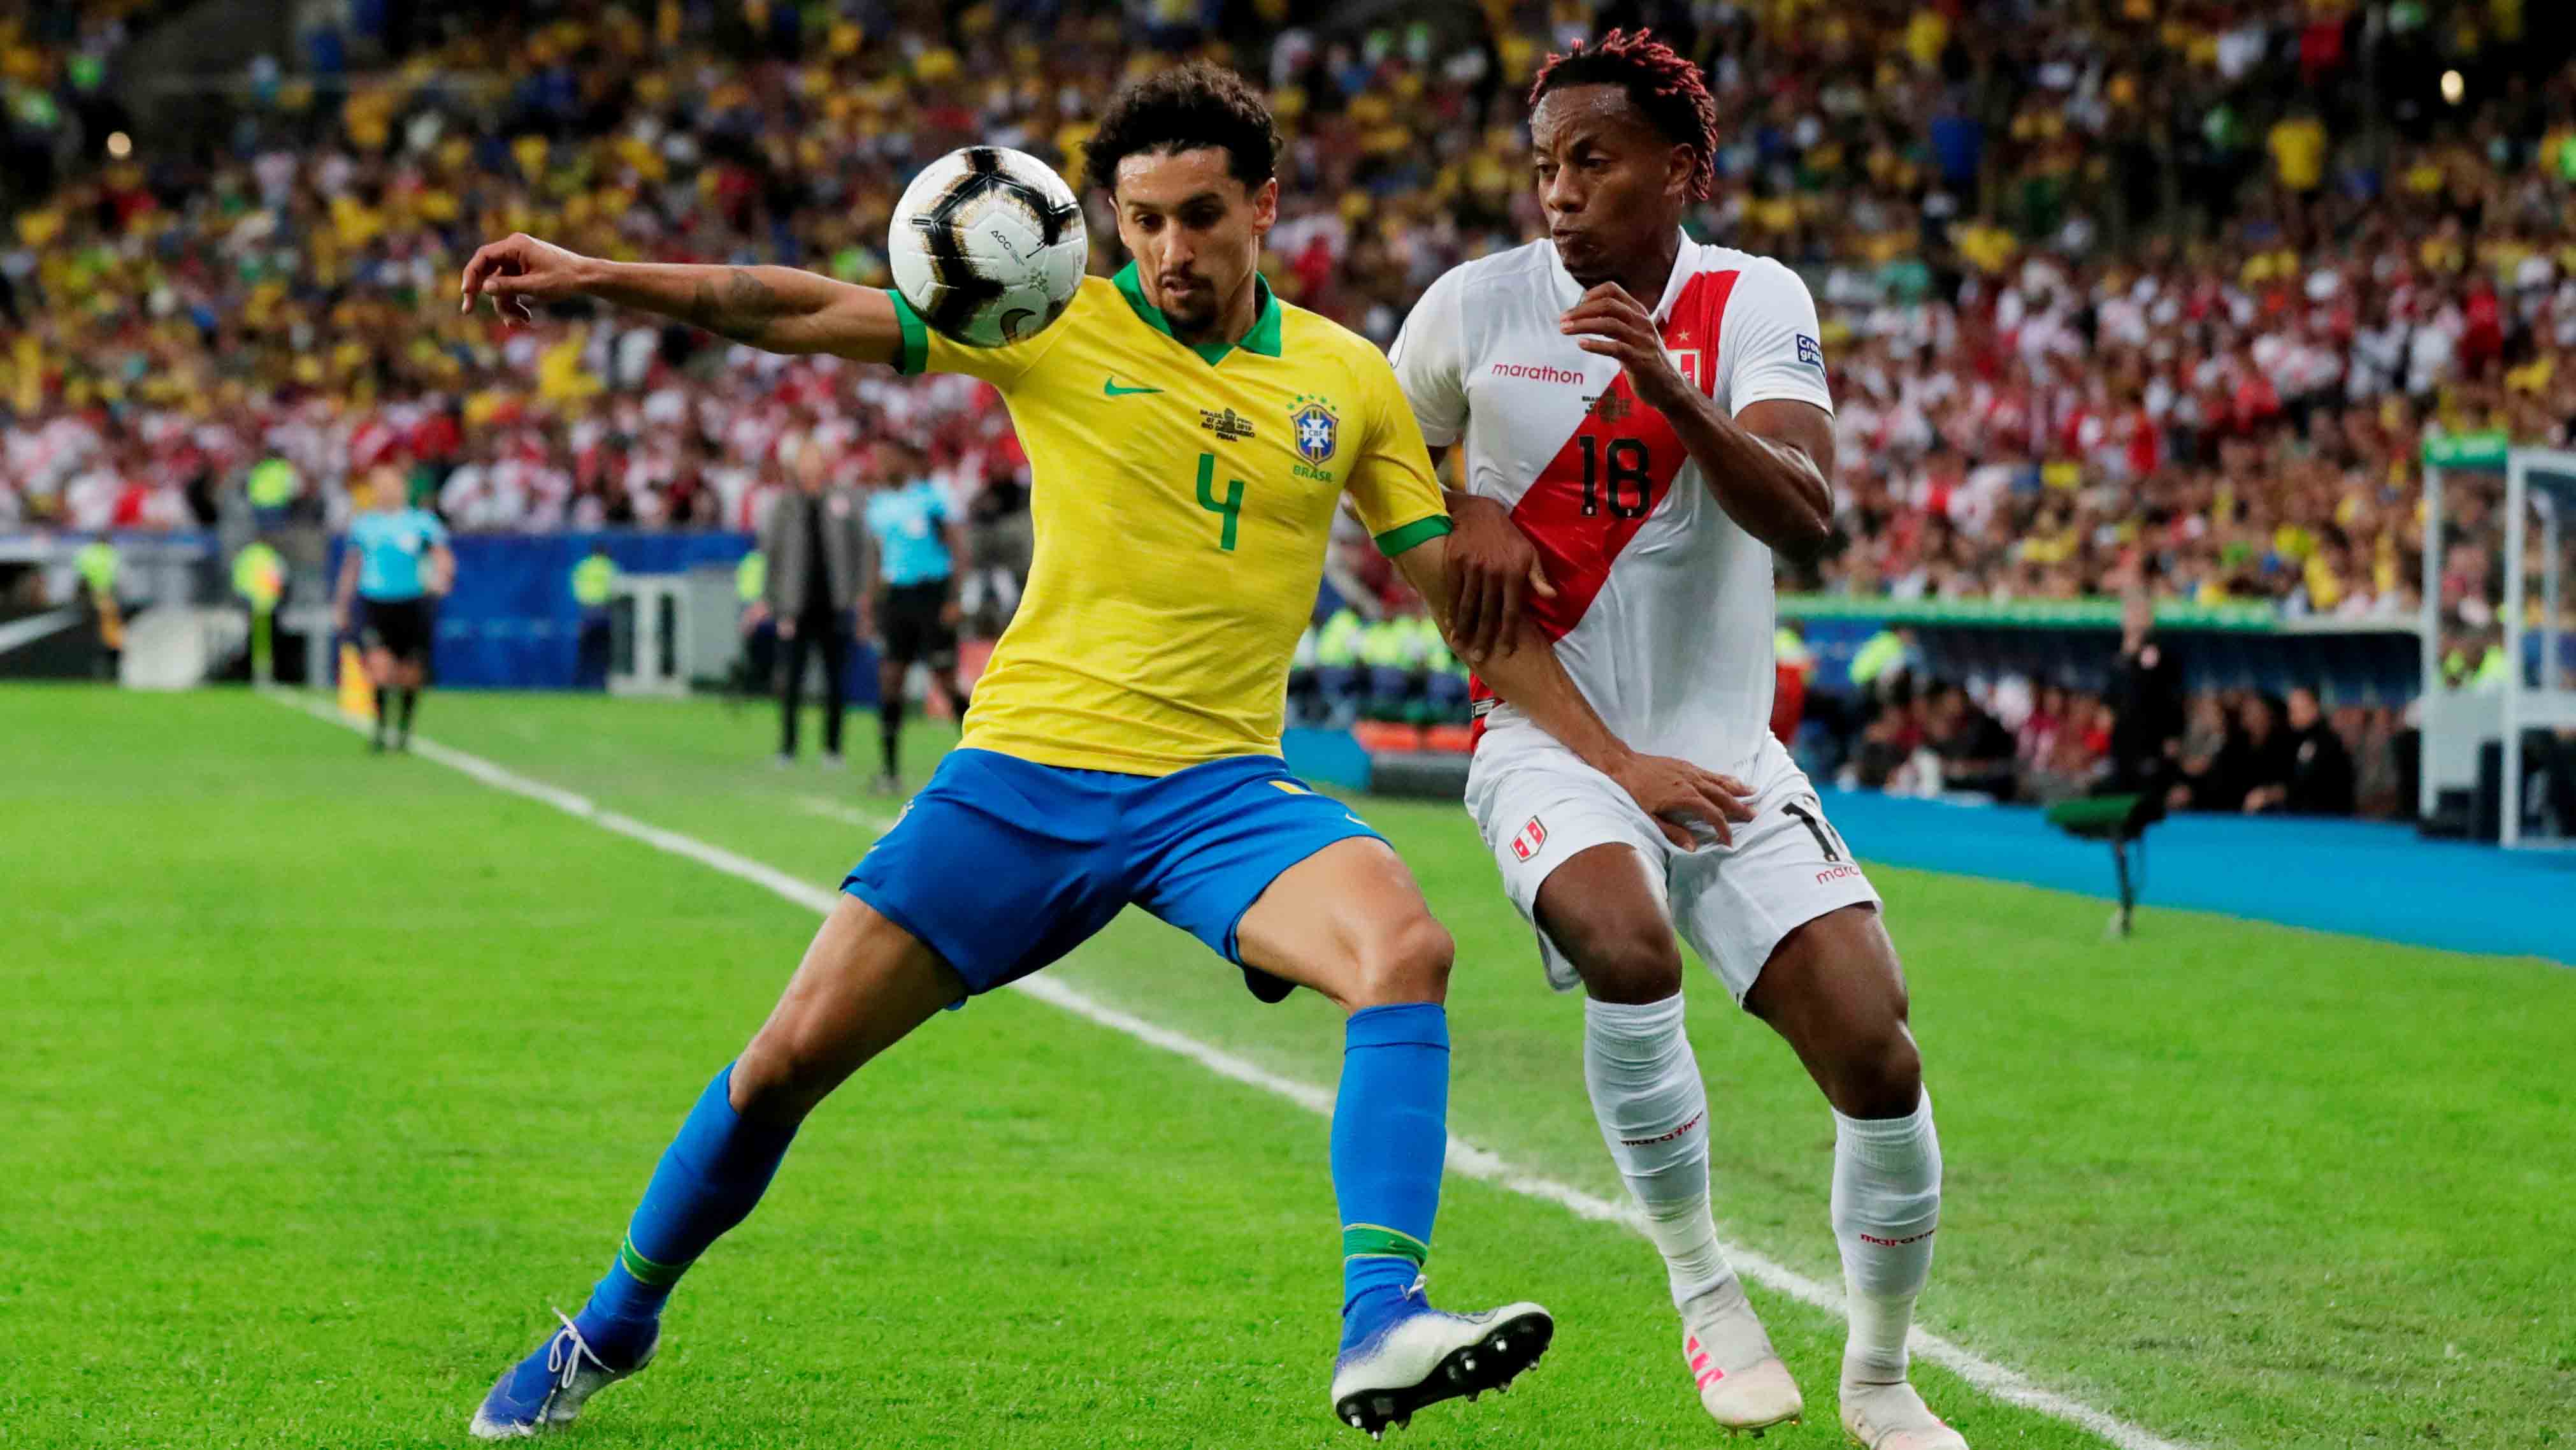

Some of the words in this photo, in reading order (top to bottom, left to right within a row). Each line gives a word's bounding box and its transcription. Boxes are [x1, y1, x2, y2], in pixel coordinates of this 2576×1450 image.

[1492, 362, 1585, 385] marathon
[1308, 429, 1325, 437] CBF
[1293, 464, 1336, 484] BRASIL
[1578, 435, 1652, 520] 18
[1196, 453, 1245, 551] 4
